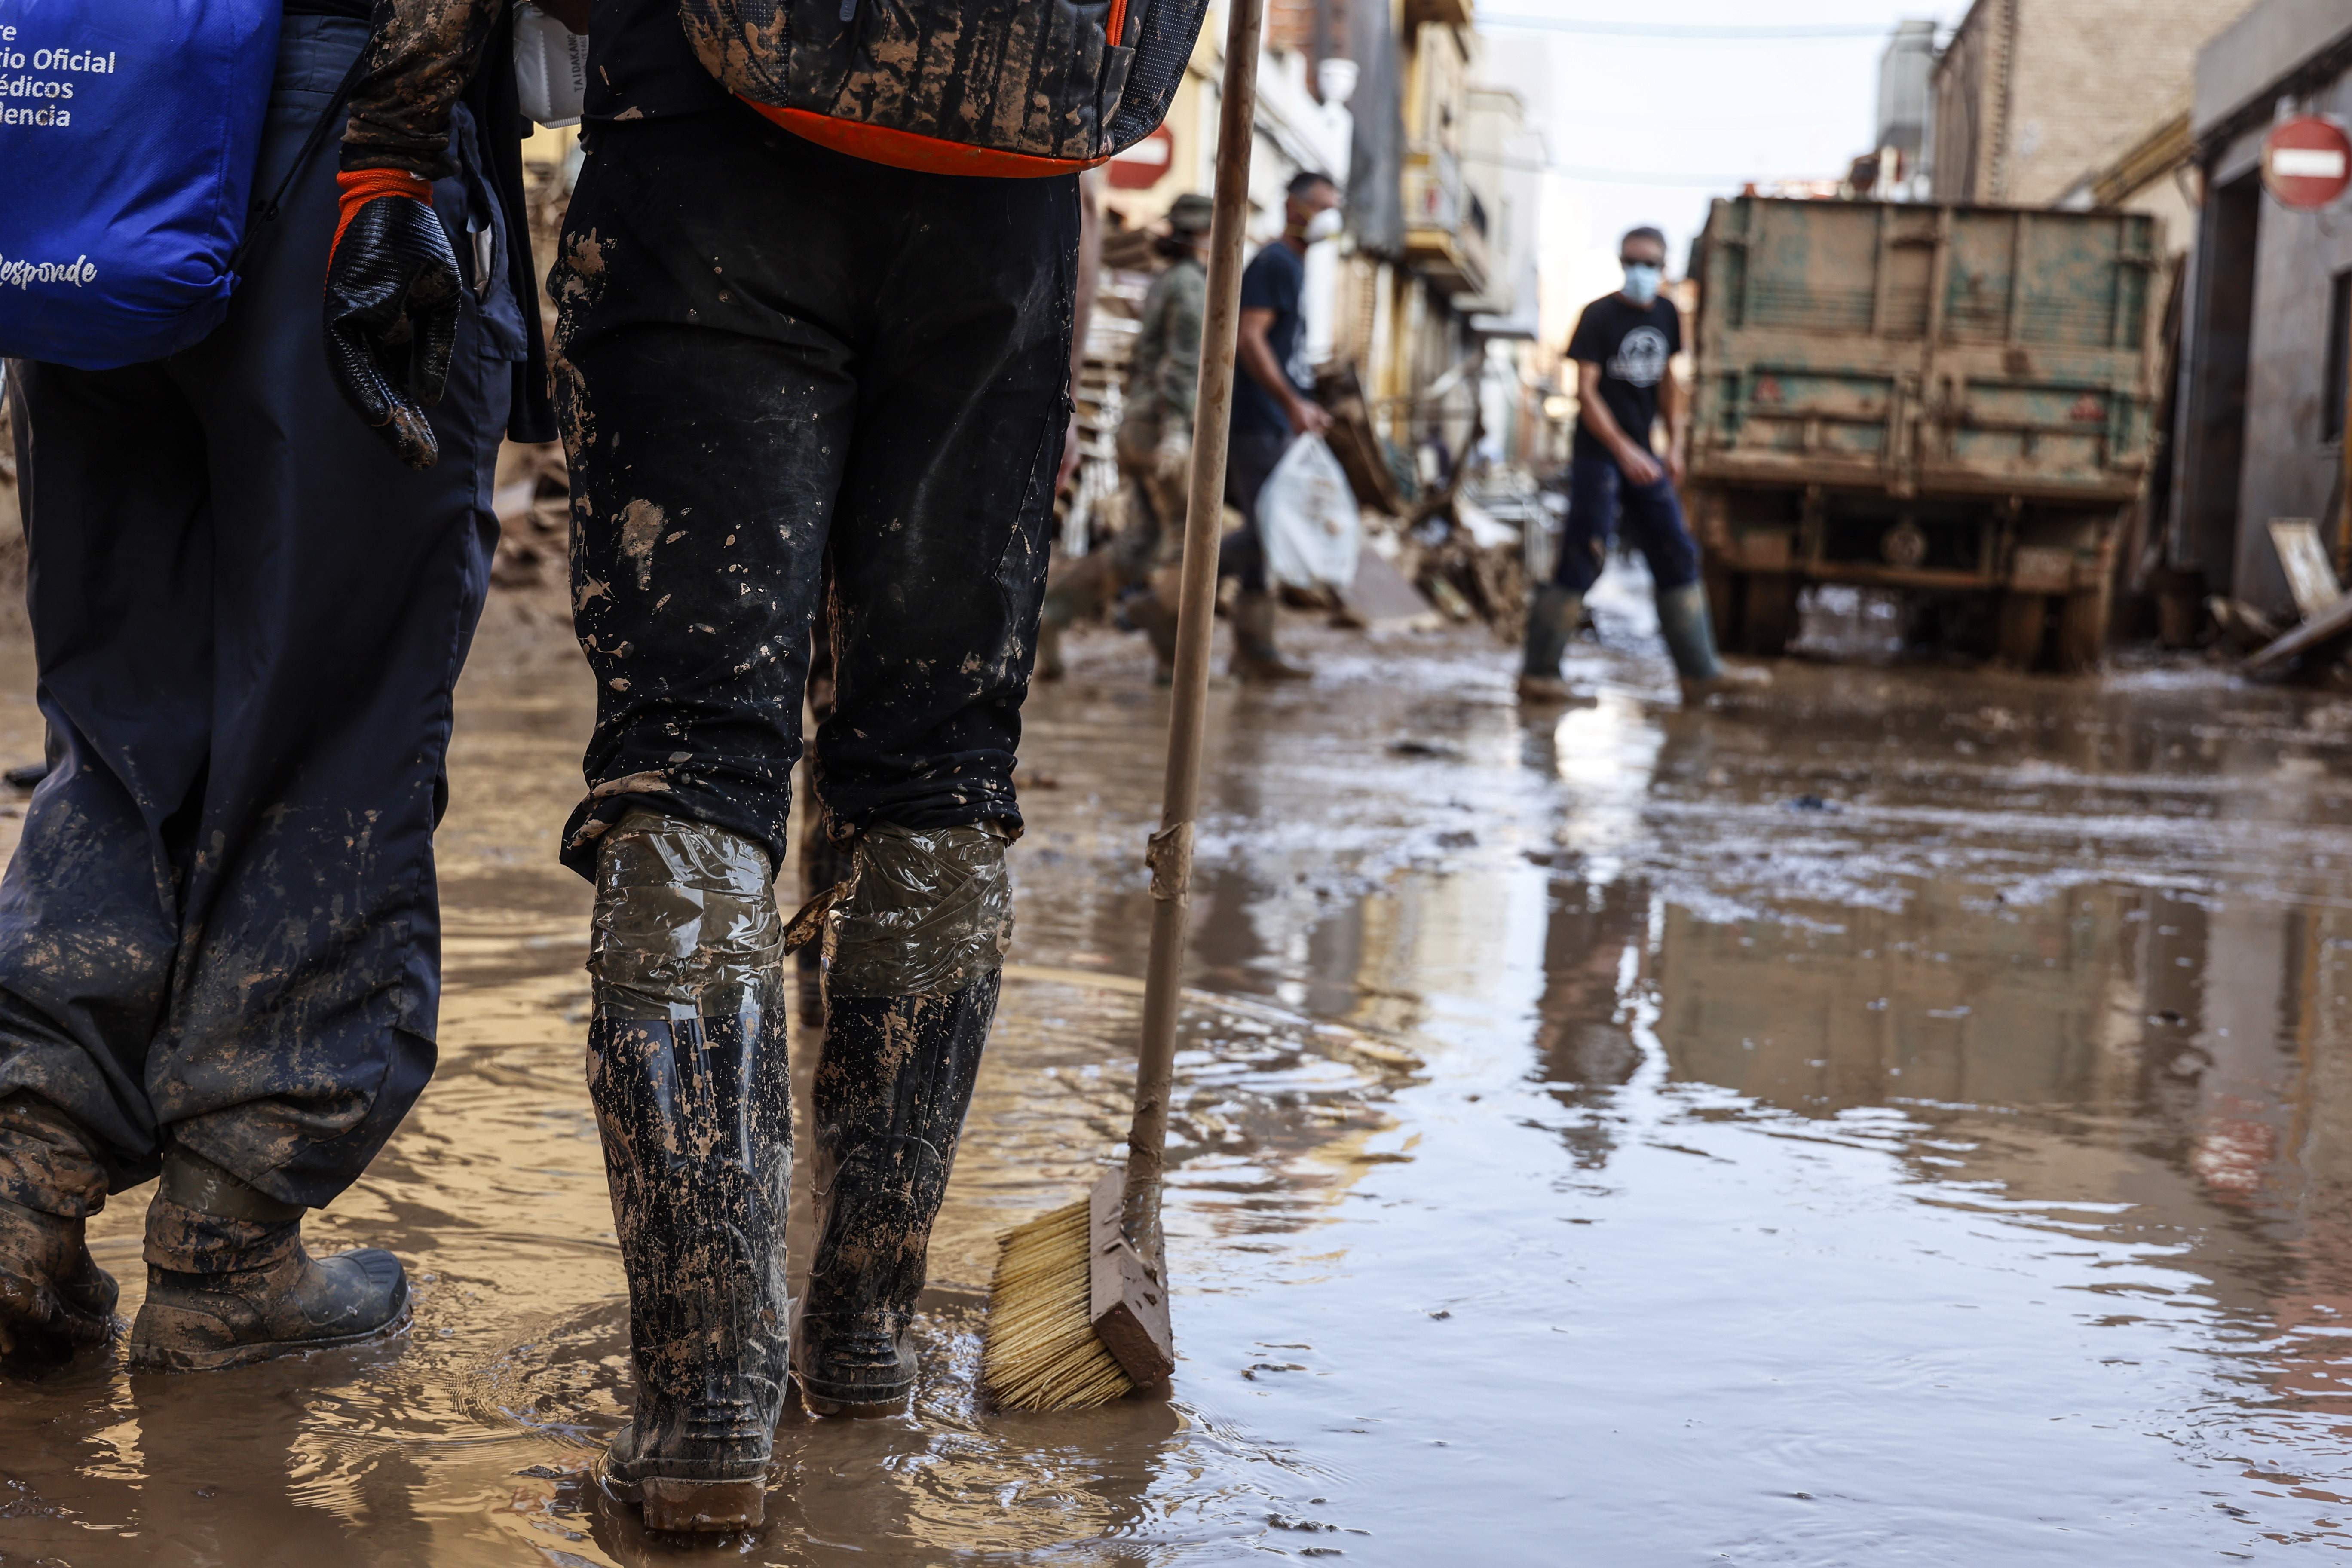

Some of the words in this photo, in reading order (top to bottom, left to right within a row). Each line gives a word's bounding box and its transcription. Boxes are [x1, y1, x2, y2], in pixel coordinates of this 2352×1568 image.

[0, 47, 25, 69] io
[33, 48, 115, 73] Oficial
[567, 34, 583, 92] TAIDAKANG
[0, 74, 74, 99] édicos
[0, 252, 98, 291] esponde
